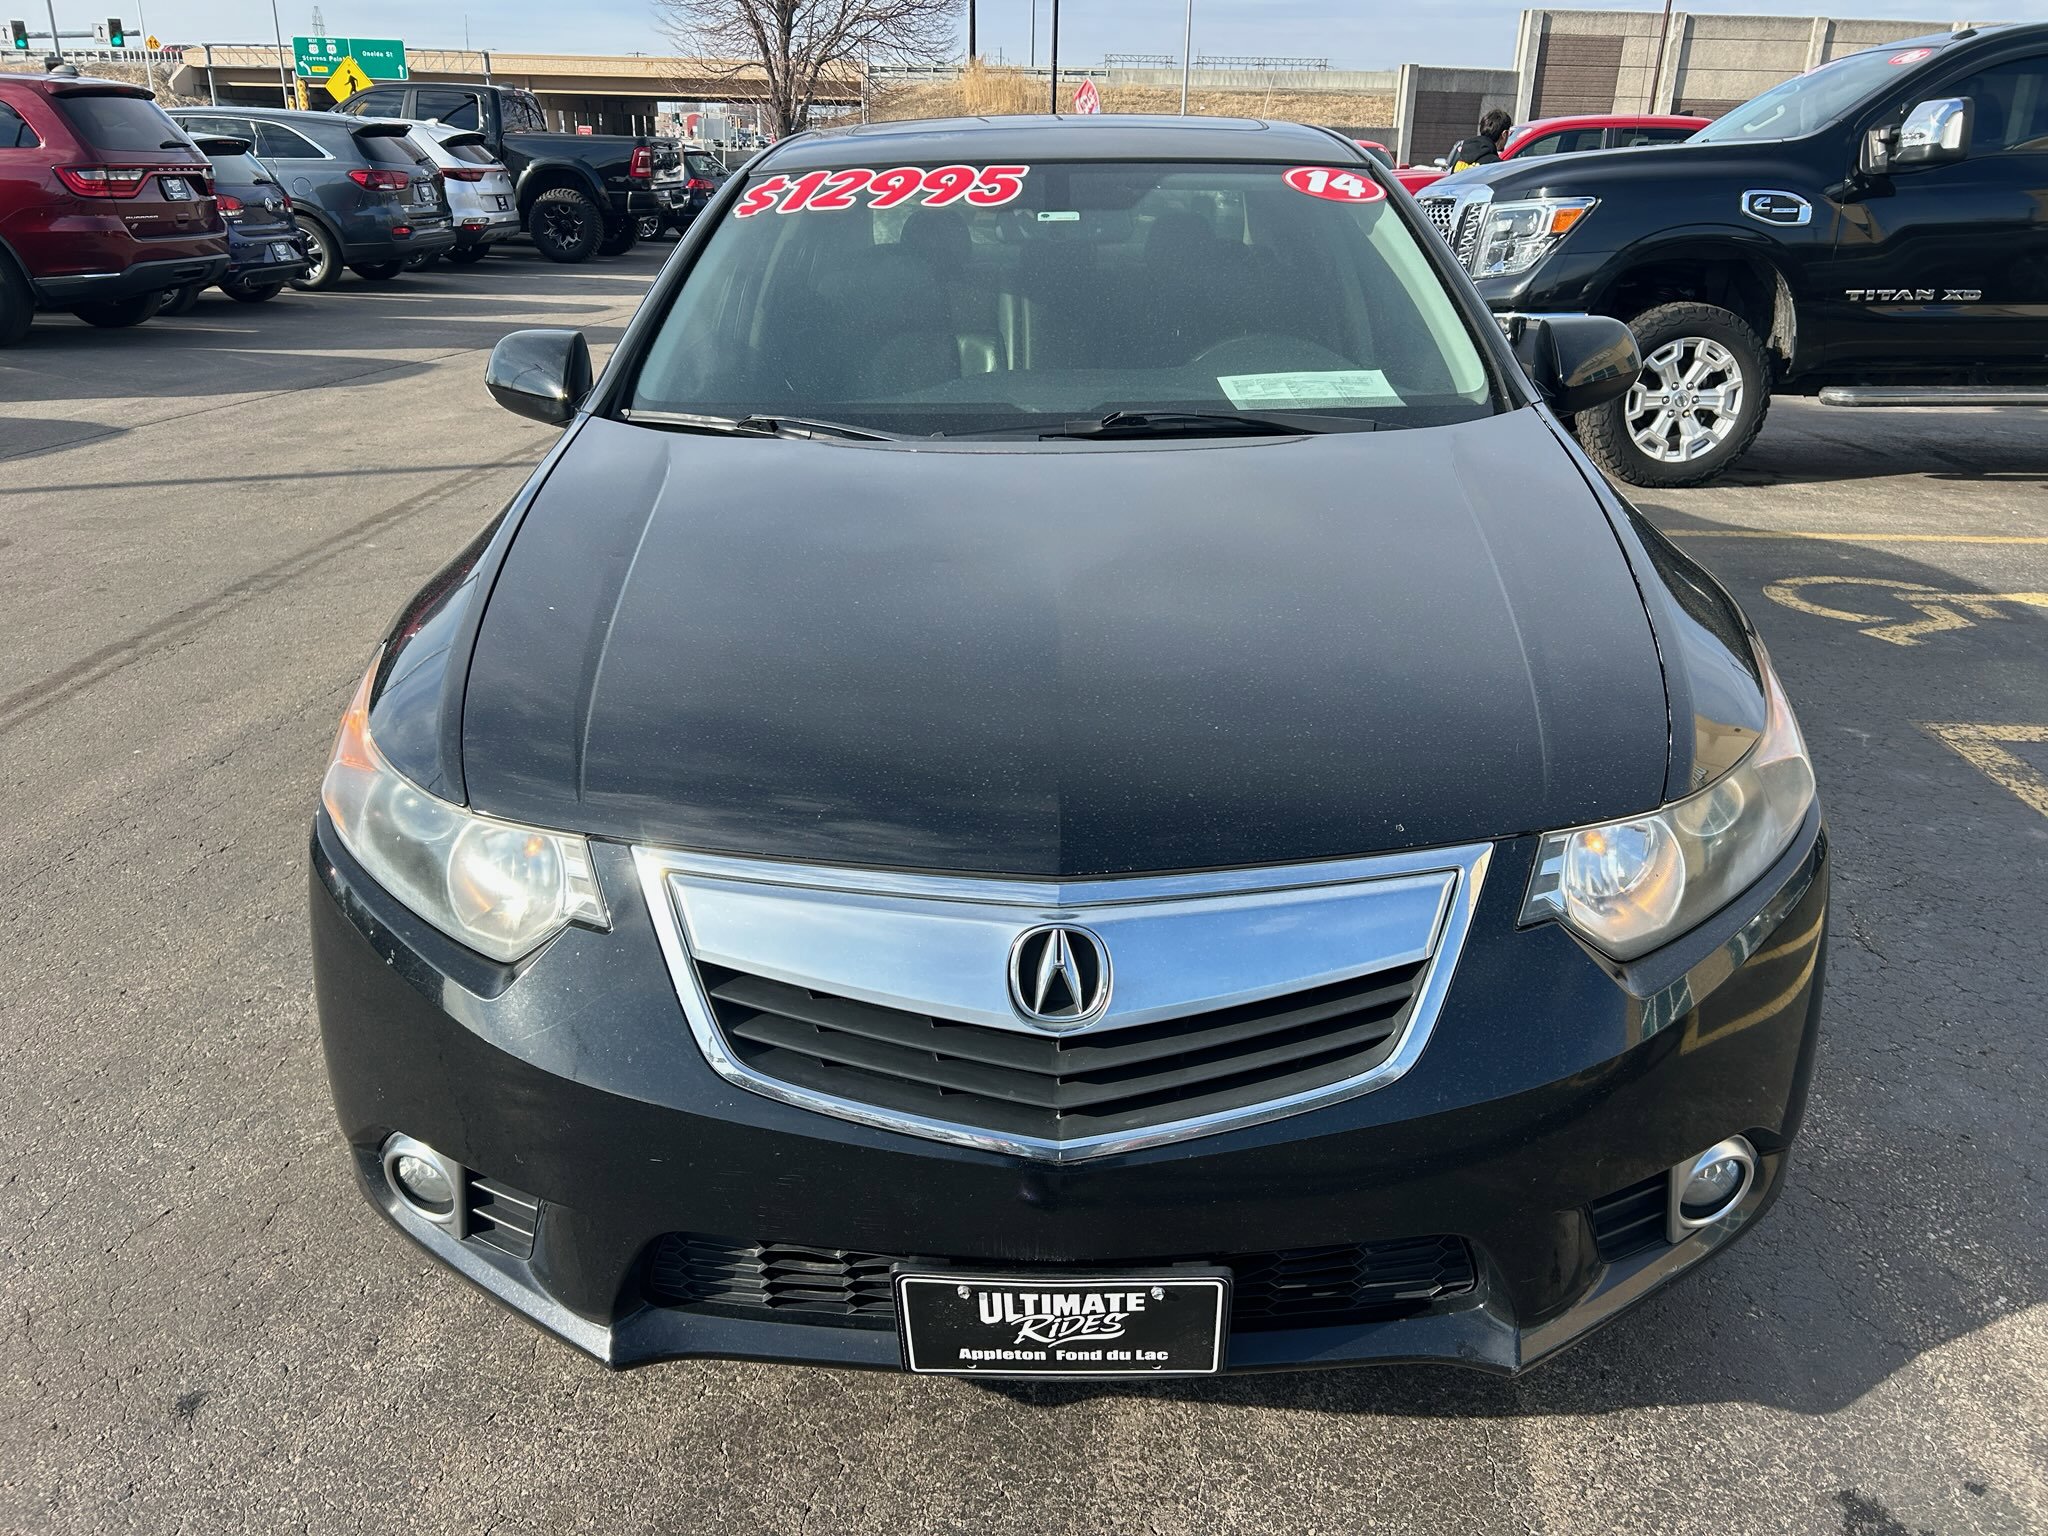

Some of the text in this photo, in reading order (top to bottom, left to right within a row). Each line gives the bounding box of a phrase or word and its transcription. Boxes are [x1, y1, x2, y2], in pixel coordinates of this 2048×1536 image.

[733, 165, 1030, 218] $12995
[1306, 170, 1366, 197] 14
[1845, 289, 1982, 300] TITAN XD
[978, 1292, 1146, 1325] ULTIMATE
[959, 1348, 1169, 1361] Appleton Fond du Lac
